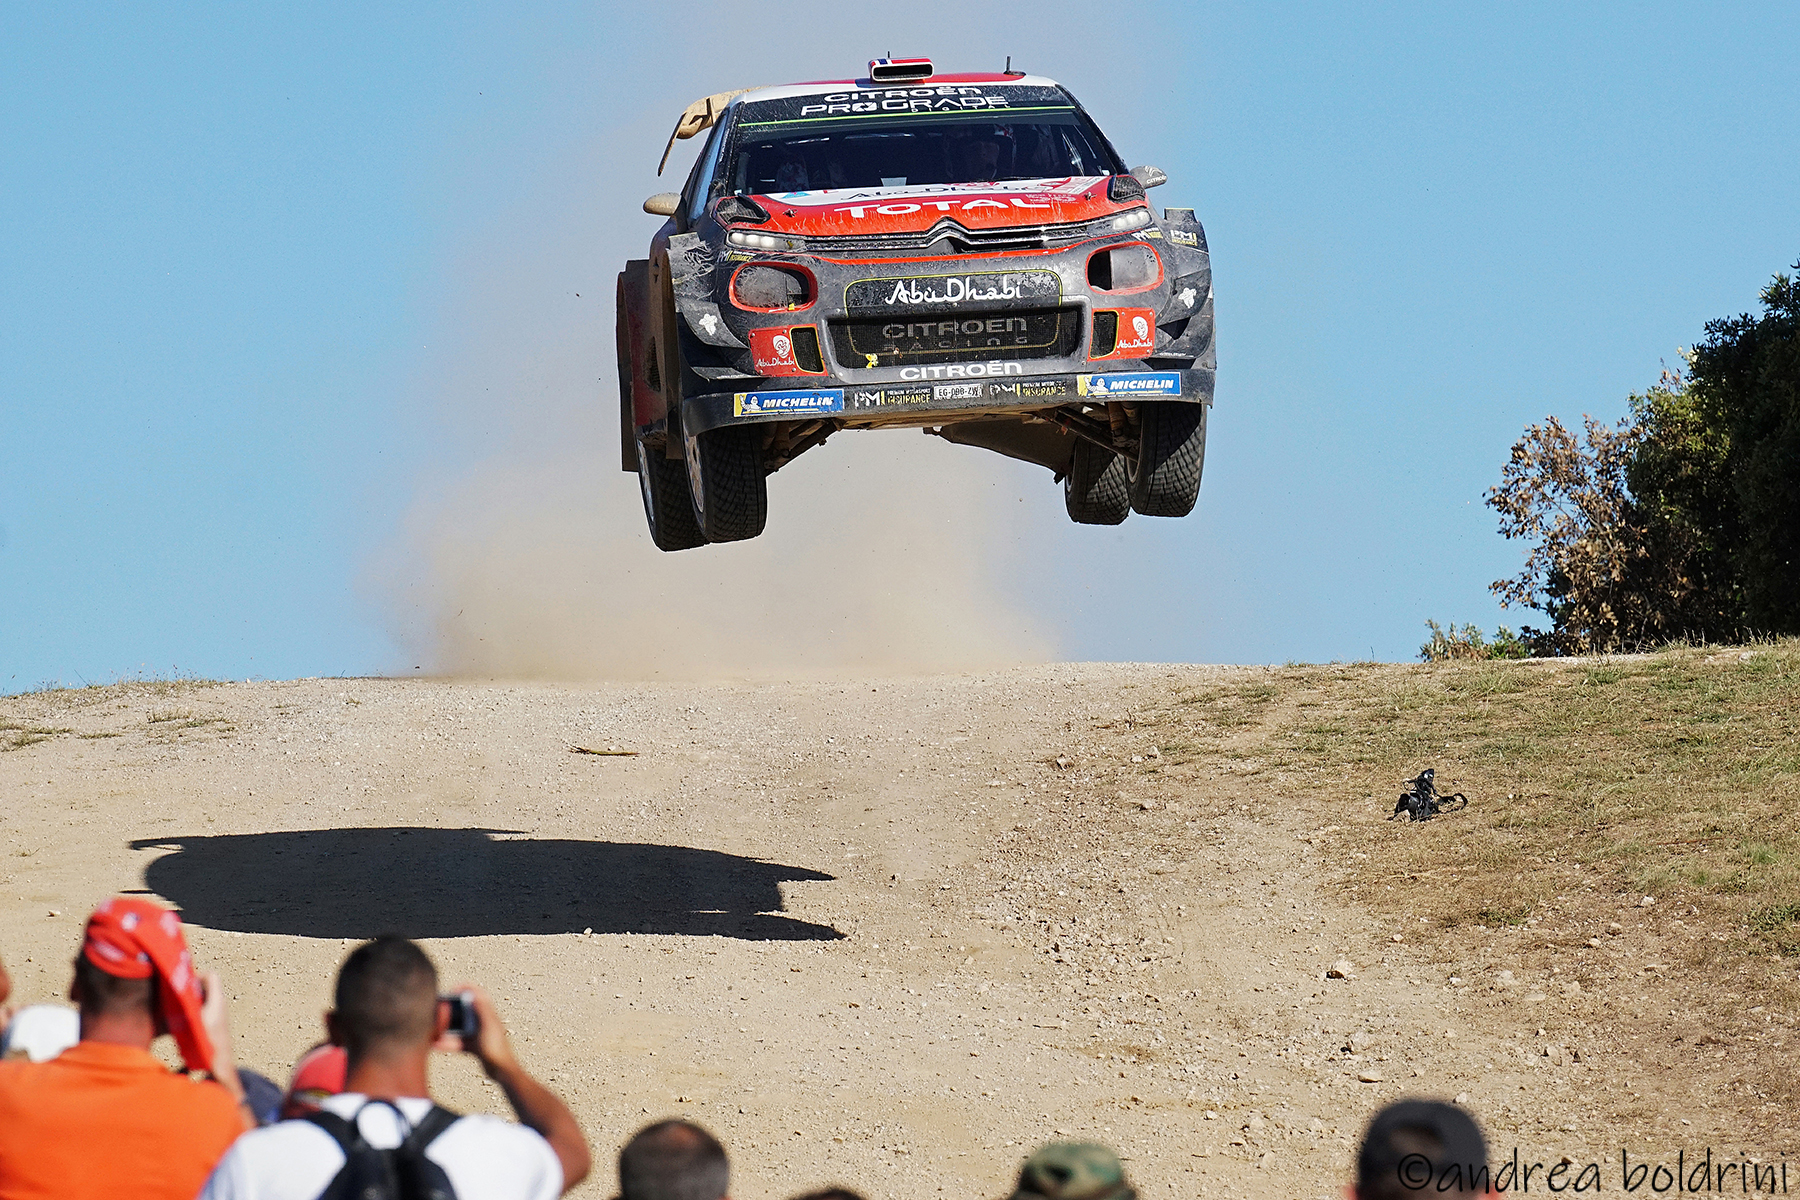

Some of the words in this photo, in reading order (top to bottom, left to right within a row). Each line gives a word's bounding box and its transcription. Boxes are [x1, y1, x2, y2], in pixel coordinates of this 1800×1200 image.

[834, 198, 1050, 218] TOTAL
[1110, 380, 1174, 390] MICHELIN
[763, 396, 834, 409] MICHELIN
